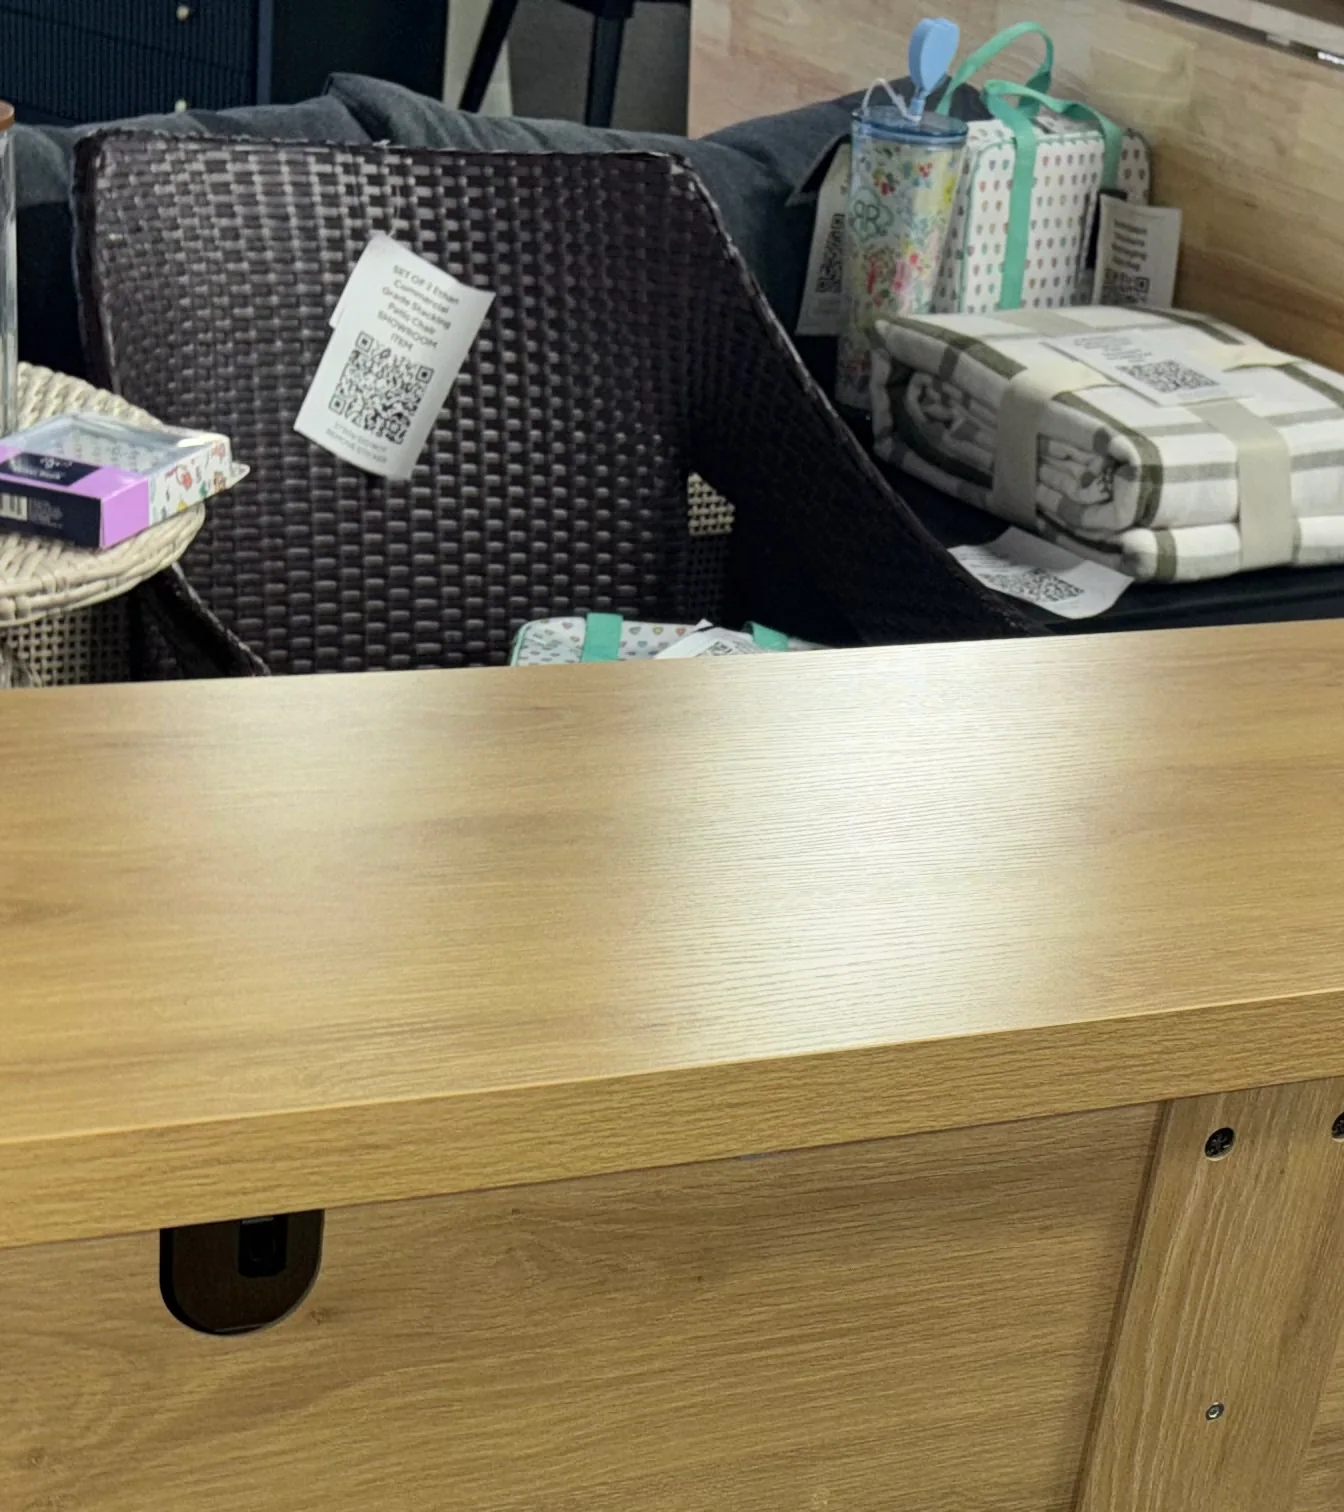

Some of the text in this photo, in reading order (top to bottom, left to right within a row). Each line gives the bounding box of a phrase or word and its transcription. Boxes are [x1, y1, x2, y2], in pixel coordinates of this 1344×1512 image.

[393, 264, 411, 279] SET
[411, 274, 425, 286] OF
[382, 286, 452, 331] Grade Stacking
[394, 279, 450, 314] Commercial
[378, 310, 438, 349] SHOWROOM
[388, 302, 436, 335] Patio Chair
[390, 332, 414, 352] ITEM
